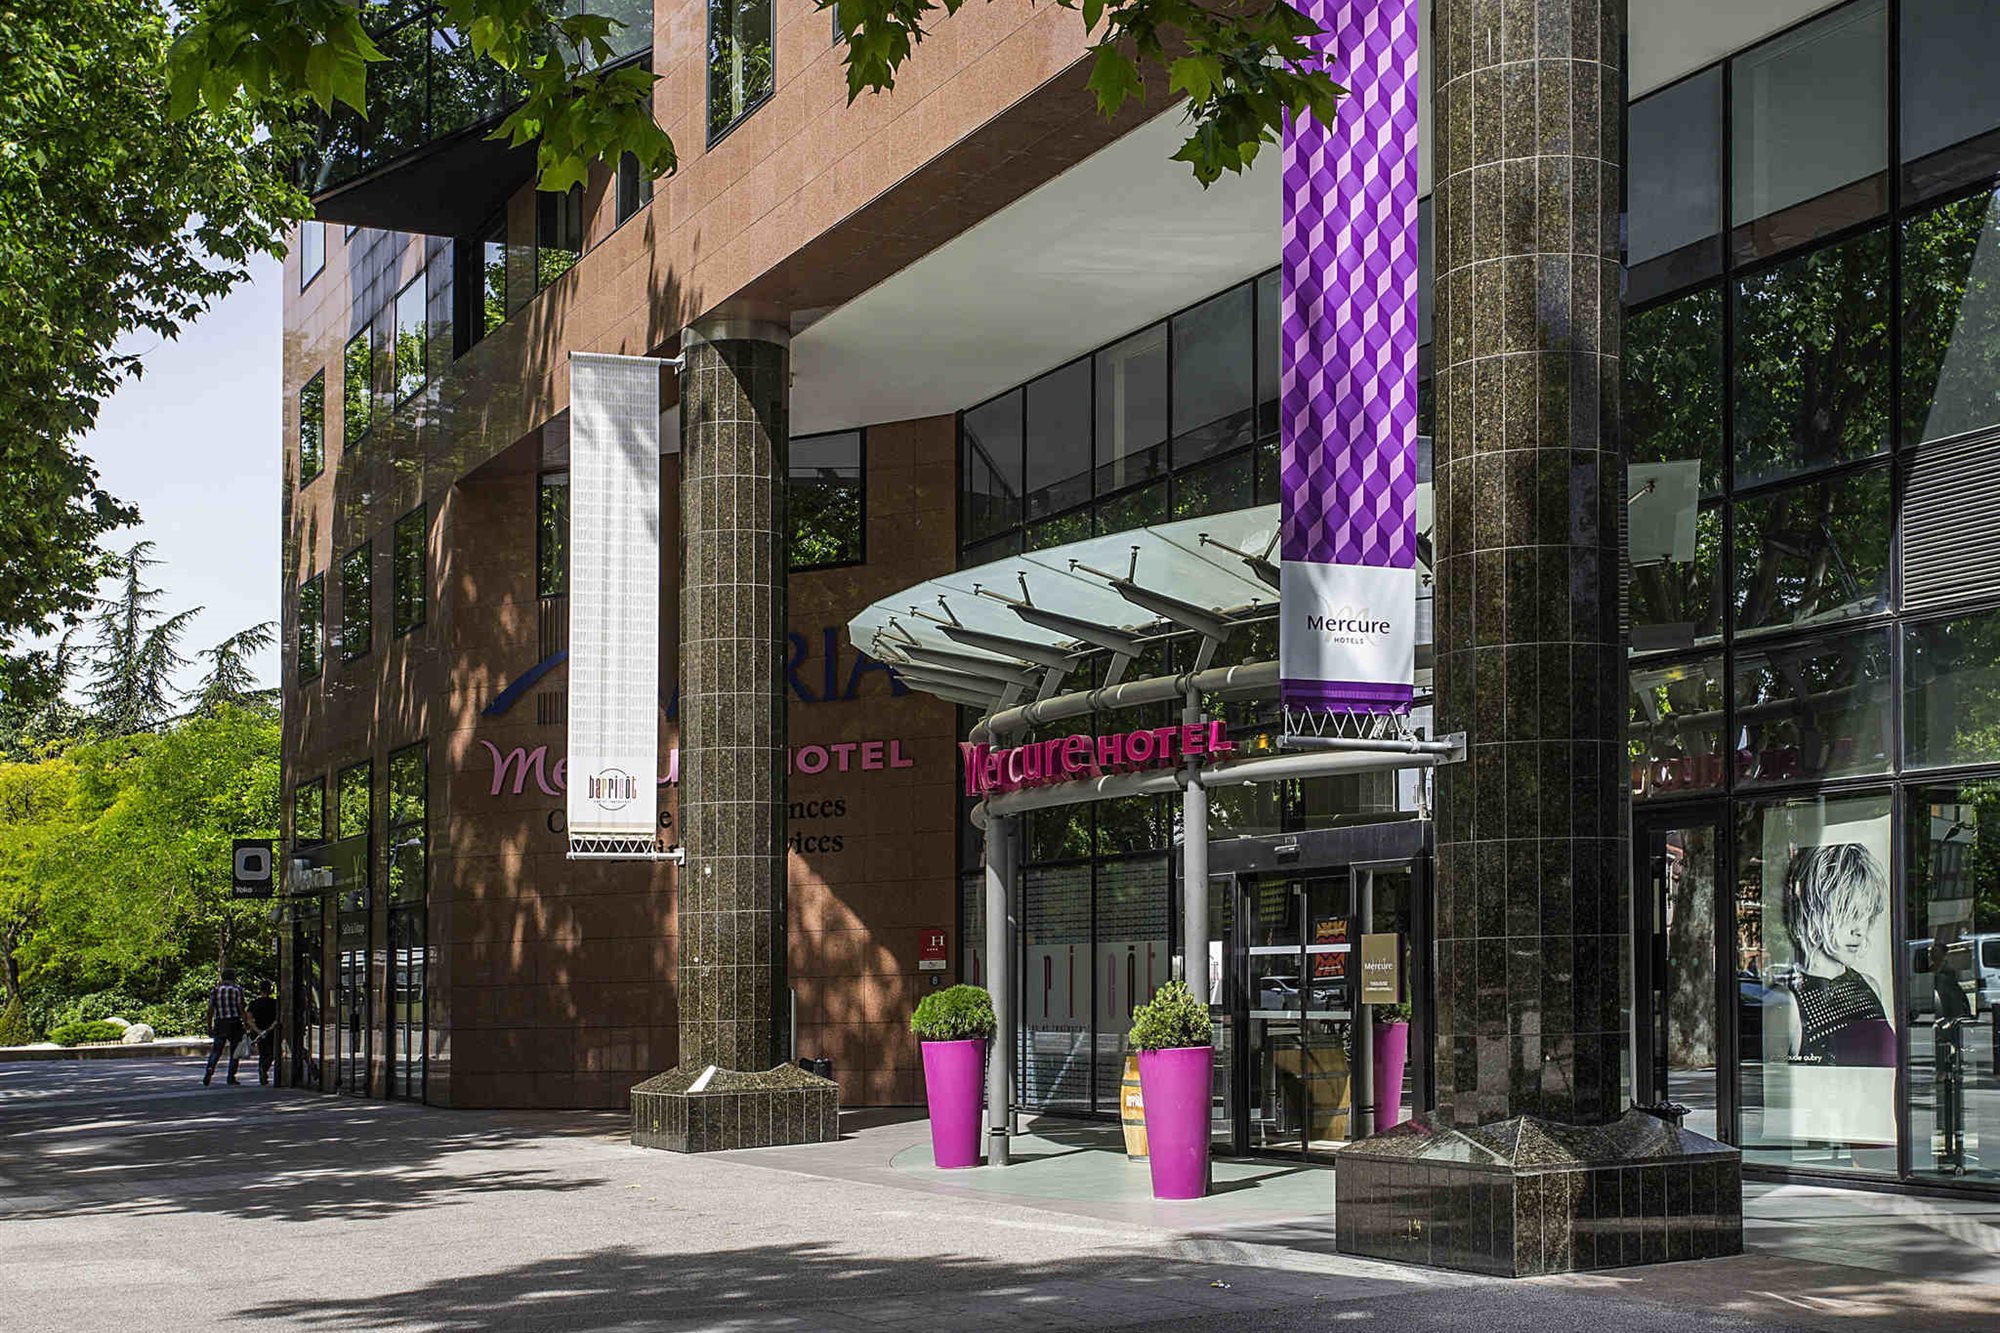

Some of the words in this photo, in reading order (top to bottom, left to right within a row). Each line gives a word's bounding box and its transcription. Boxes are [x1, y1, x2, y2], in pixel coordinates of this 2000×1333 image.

[1307, 615, 1391, 635] Mercure
[1333, 637, 1364, 645] HOTELS
[787, 739, 914, 775] OTEL
[958, 734, 1093, 797] Mercure
[1098, 720, 1234, 766] HOTEL
[931, 935, 944, 946] H
